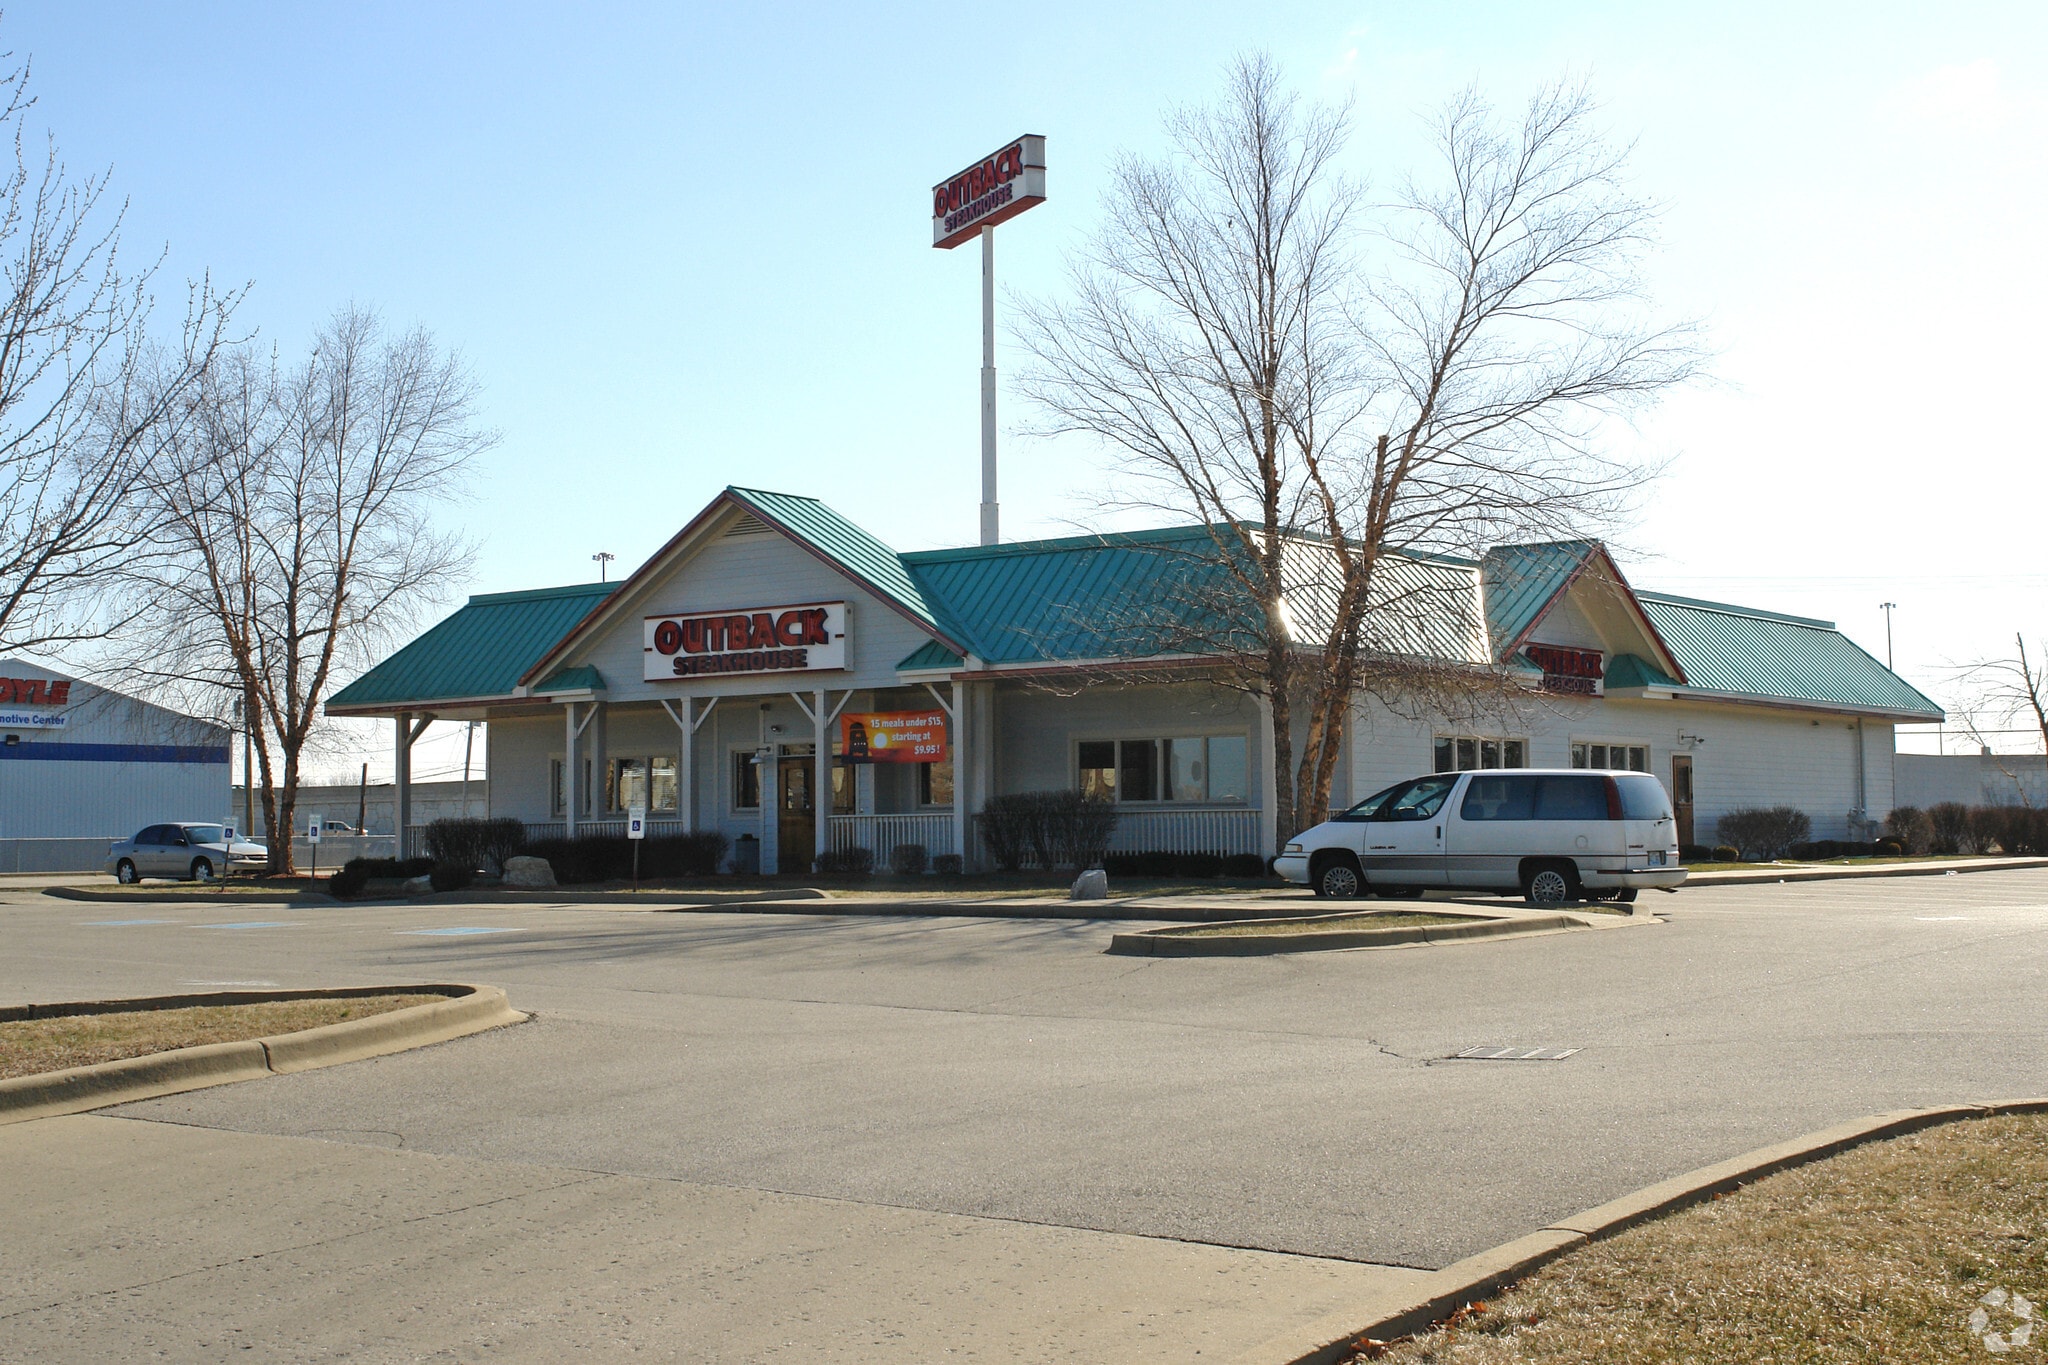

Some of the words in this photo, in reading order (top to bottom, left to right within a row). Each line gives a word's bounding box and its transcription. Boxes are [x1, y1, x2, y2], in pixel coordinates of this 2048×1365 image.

[935, 143, 1023, 218] OUTBACK
[944, 183, 1013, 233] STEAKHOUSE
[654, 608, 829, 655] OUTBACK
[673, 649, 808, 676] STEAKHOUSE
[1525, 646, 1604, 680] OUTBACK
[32, 714, 66, 725] Center
[871, 719, 880, 728] 15
[881, 718, 904, 728] meals
[905, 717, 927, 727] under
[891, 732, 922, 742] starting
[922, 731, 931, 740] at
